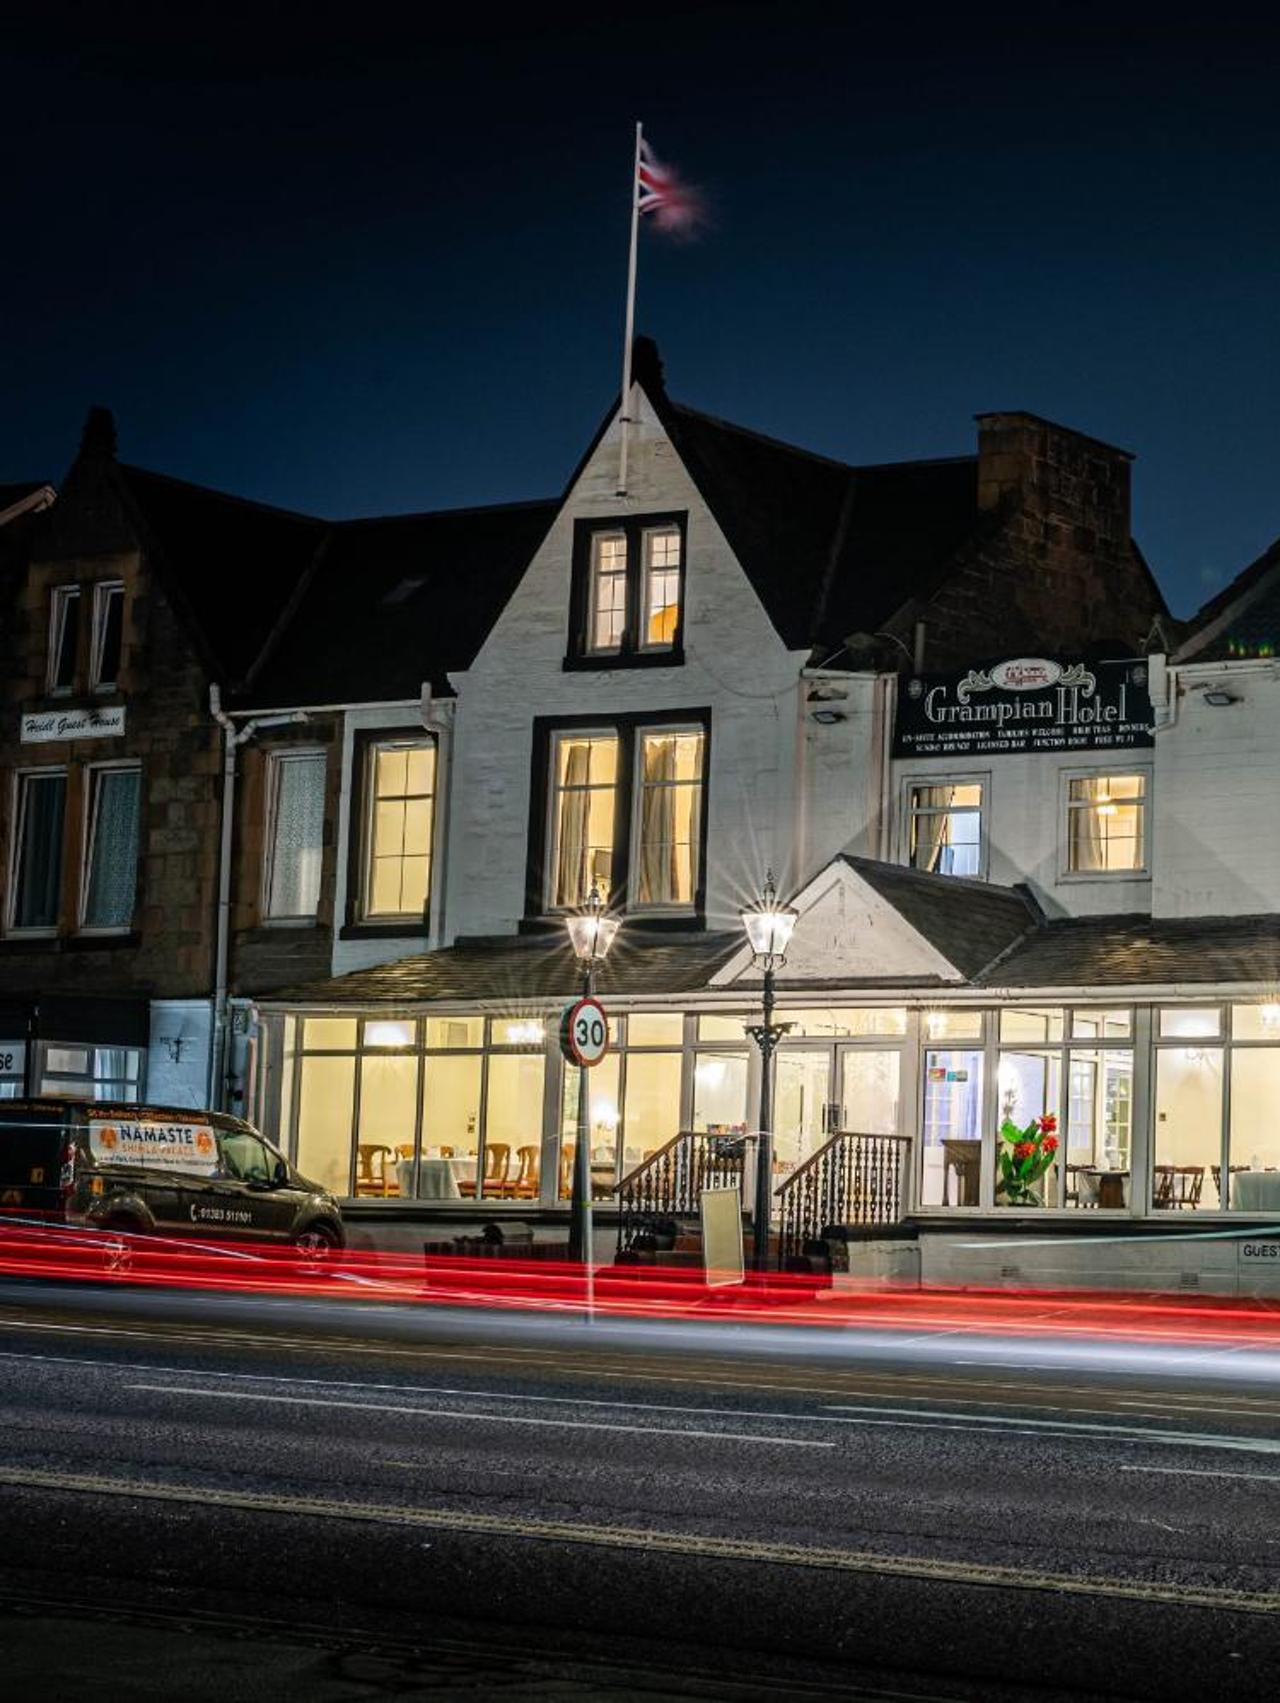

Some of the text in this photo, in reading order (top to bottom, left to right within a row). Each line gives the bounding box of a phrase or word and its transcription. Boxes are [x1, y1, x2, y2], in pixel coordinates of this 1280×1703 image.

[924, 683, 1127, 727] Grampian Hotel
[57, 717, 87, 735] Guest
[87, 711, 120, 728] House
[577, 1019, 603, 1047] 30
[120, 1125, 193, 1145] NAMASTE
